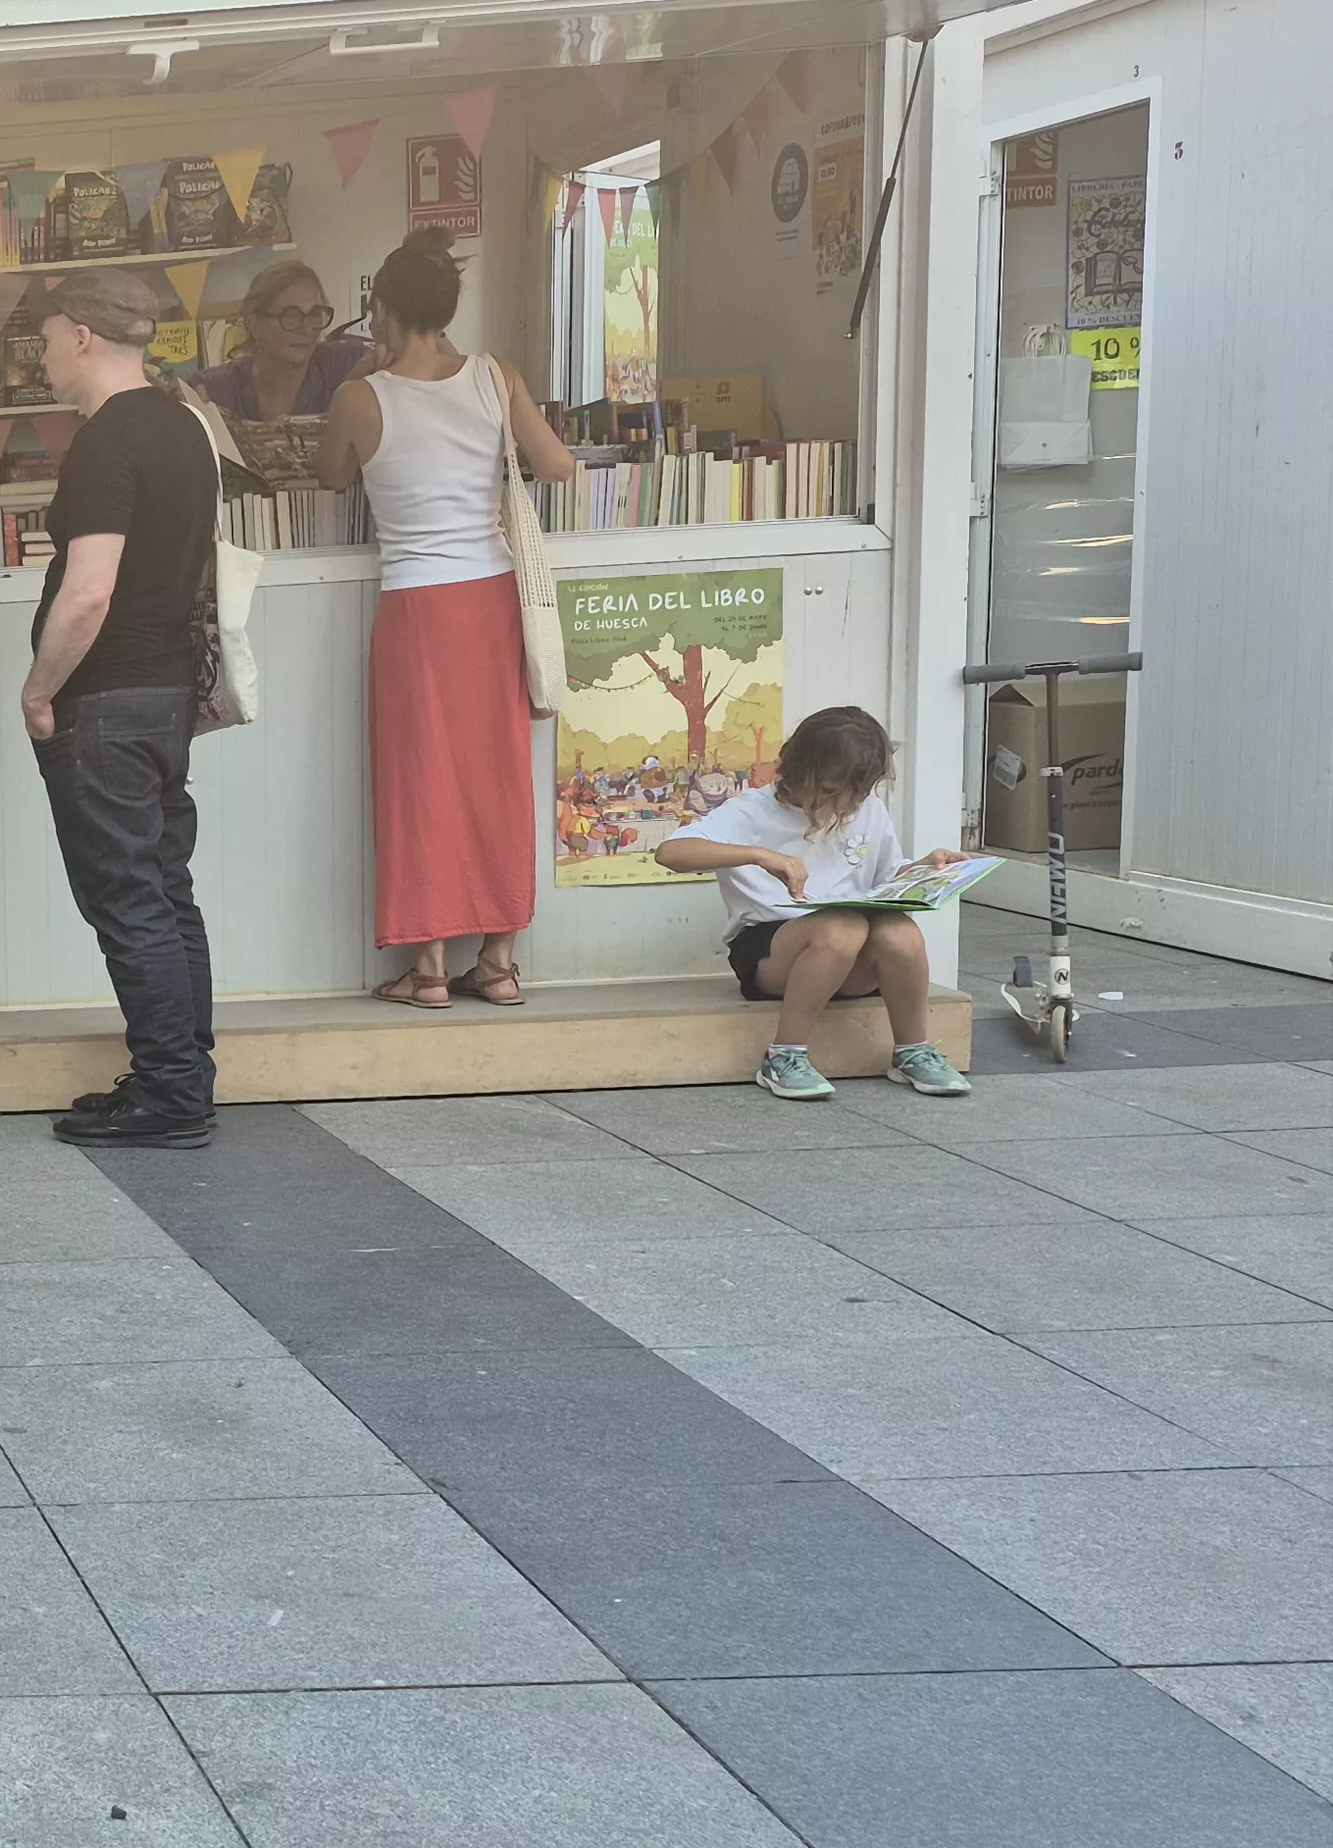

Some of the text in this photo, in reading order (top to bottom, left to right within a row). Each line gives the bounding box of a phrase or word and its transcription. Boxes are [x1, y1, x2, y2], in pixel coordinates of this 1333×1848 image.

[1134, 65, 1140, 78] 3
[1174, 141, 1184, 160] 5
[1007, 185, 1053, 201] TINTOR
[415, 216, 475, 229] EXTINTOR
[1099, 313, 1141, 324] DESCUEN
[1090, 337, 1120, 361] 10
[1091, 368, 1140, 383] ESCUE
[575, 588, 765, 615] FERIA DEL LIBRO
[574, 617, 648, 631] DE HUESCA
